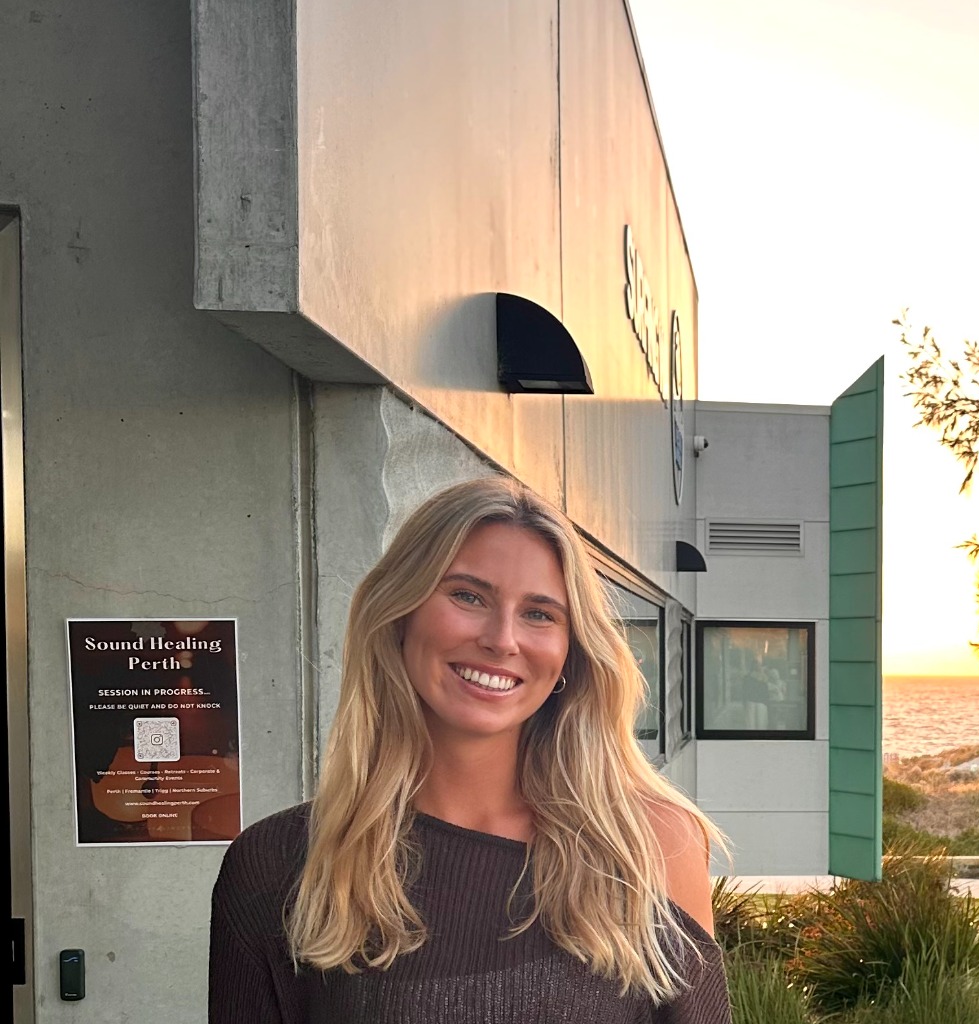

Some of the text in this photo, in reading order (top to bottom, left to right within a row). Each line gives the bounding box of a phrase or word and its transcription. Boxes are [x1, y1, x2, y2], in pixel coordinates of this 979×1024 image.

[85, 636, 222, 652] Sound Healing
[128, 656, 180, 670] Perth
